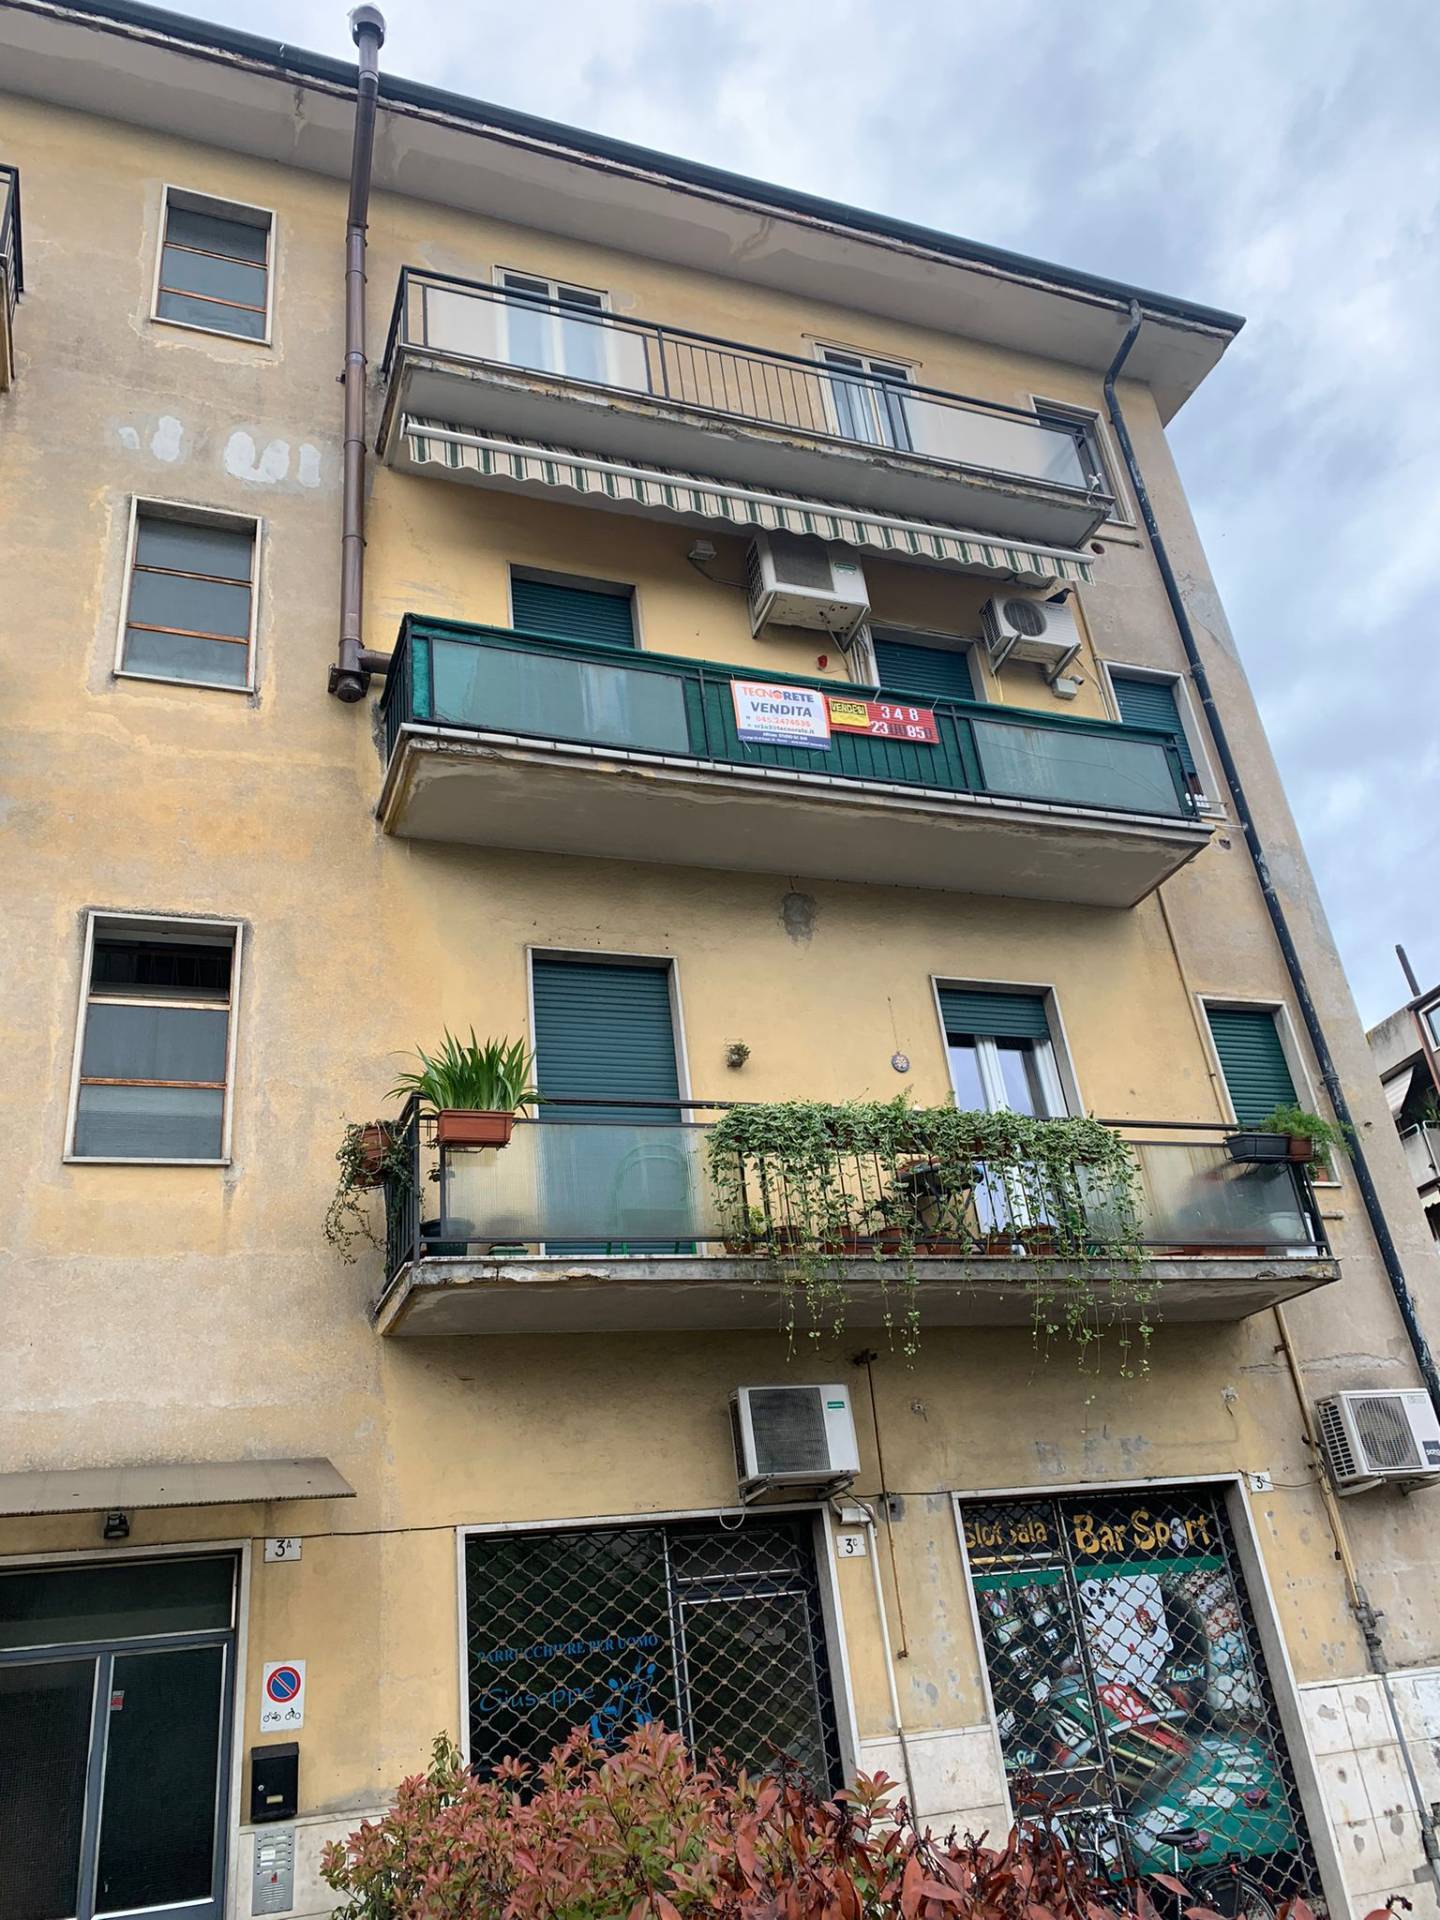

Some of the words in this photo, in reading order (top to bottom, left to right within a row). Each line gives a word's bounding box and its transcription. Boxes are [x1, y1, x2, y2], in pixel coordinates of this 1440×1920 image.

[742, 687, 815, 702] TECNORETE
[751, 701, 812, 718] VENDITA
[1073, 1514, 1125, 1554] Bar
[1131, 1509, 1211, 1550] Sport
[618, 1634, 659, 1650] UOMO
